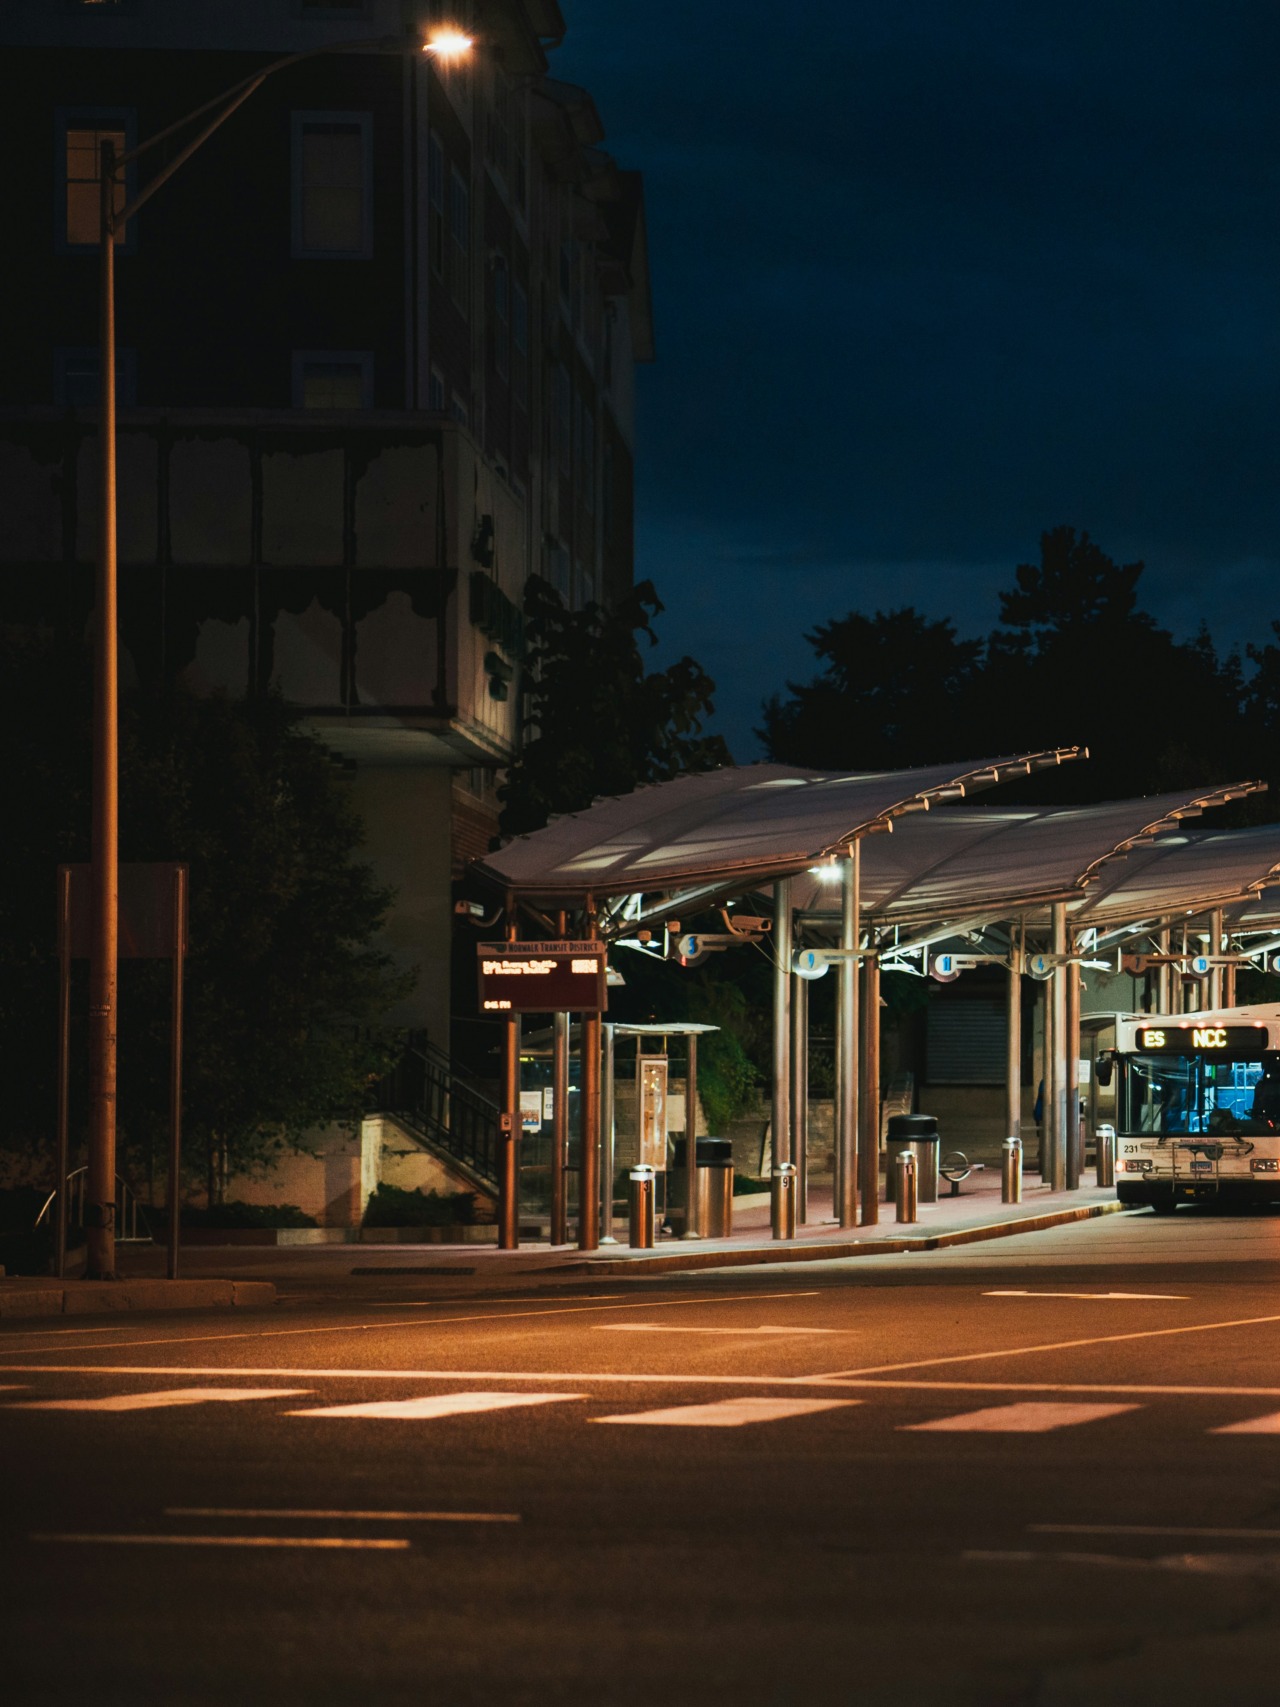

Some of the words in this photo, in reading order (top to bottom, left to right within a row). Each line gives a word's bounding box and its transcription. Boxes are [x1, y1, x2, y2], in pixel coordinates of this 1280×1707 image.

[508, 943, 539, 952] NORWALK
[540, 942, 568, 952] TRANSIT
[570, 942, 598, 952] DISTRICT
[1193, 1029, 1227, 1048] NCC
[1124, 1145, 1138, 1153] 231
[643, 1181, 649, 1191] 3
[783, 1177, 788, 1187] 9
